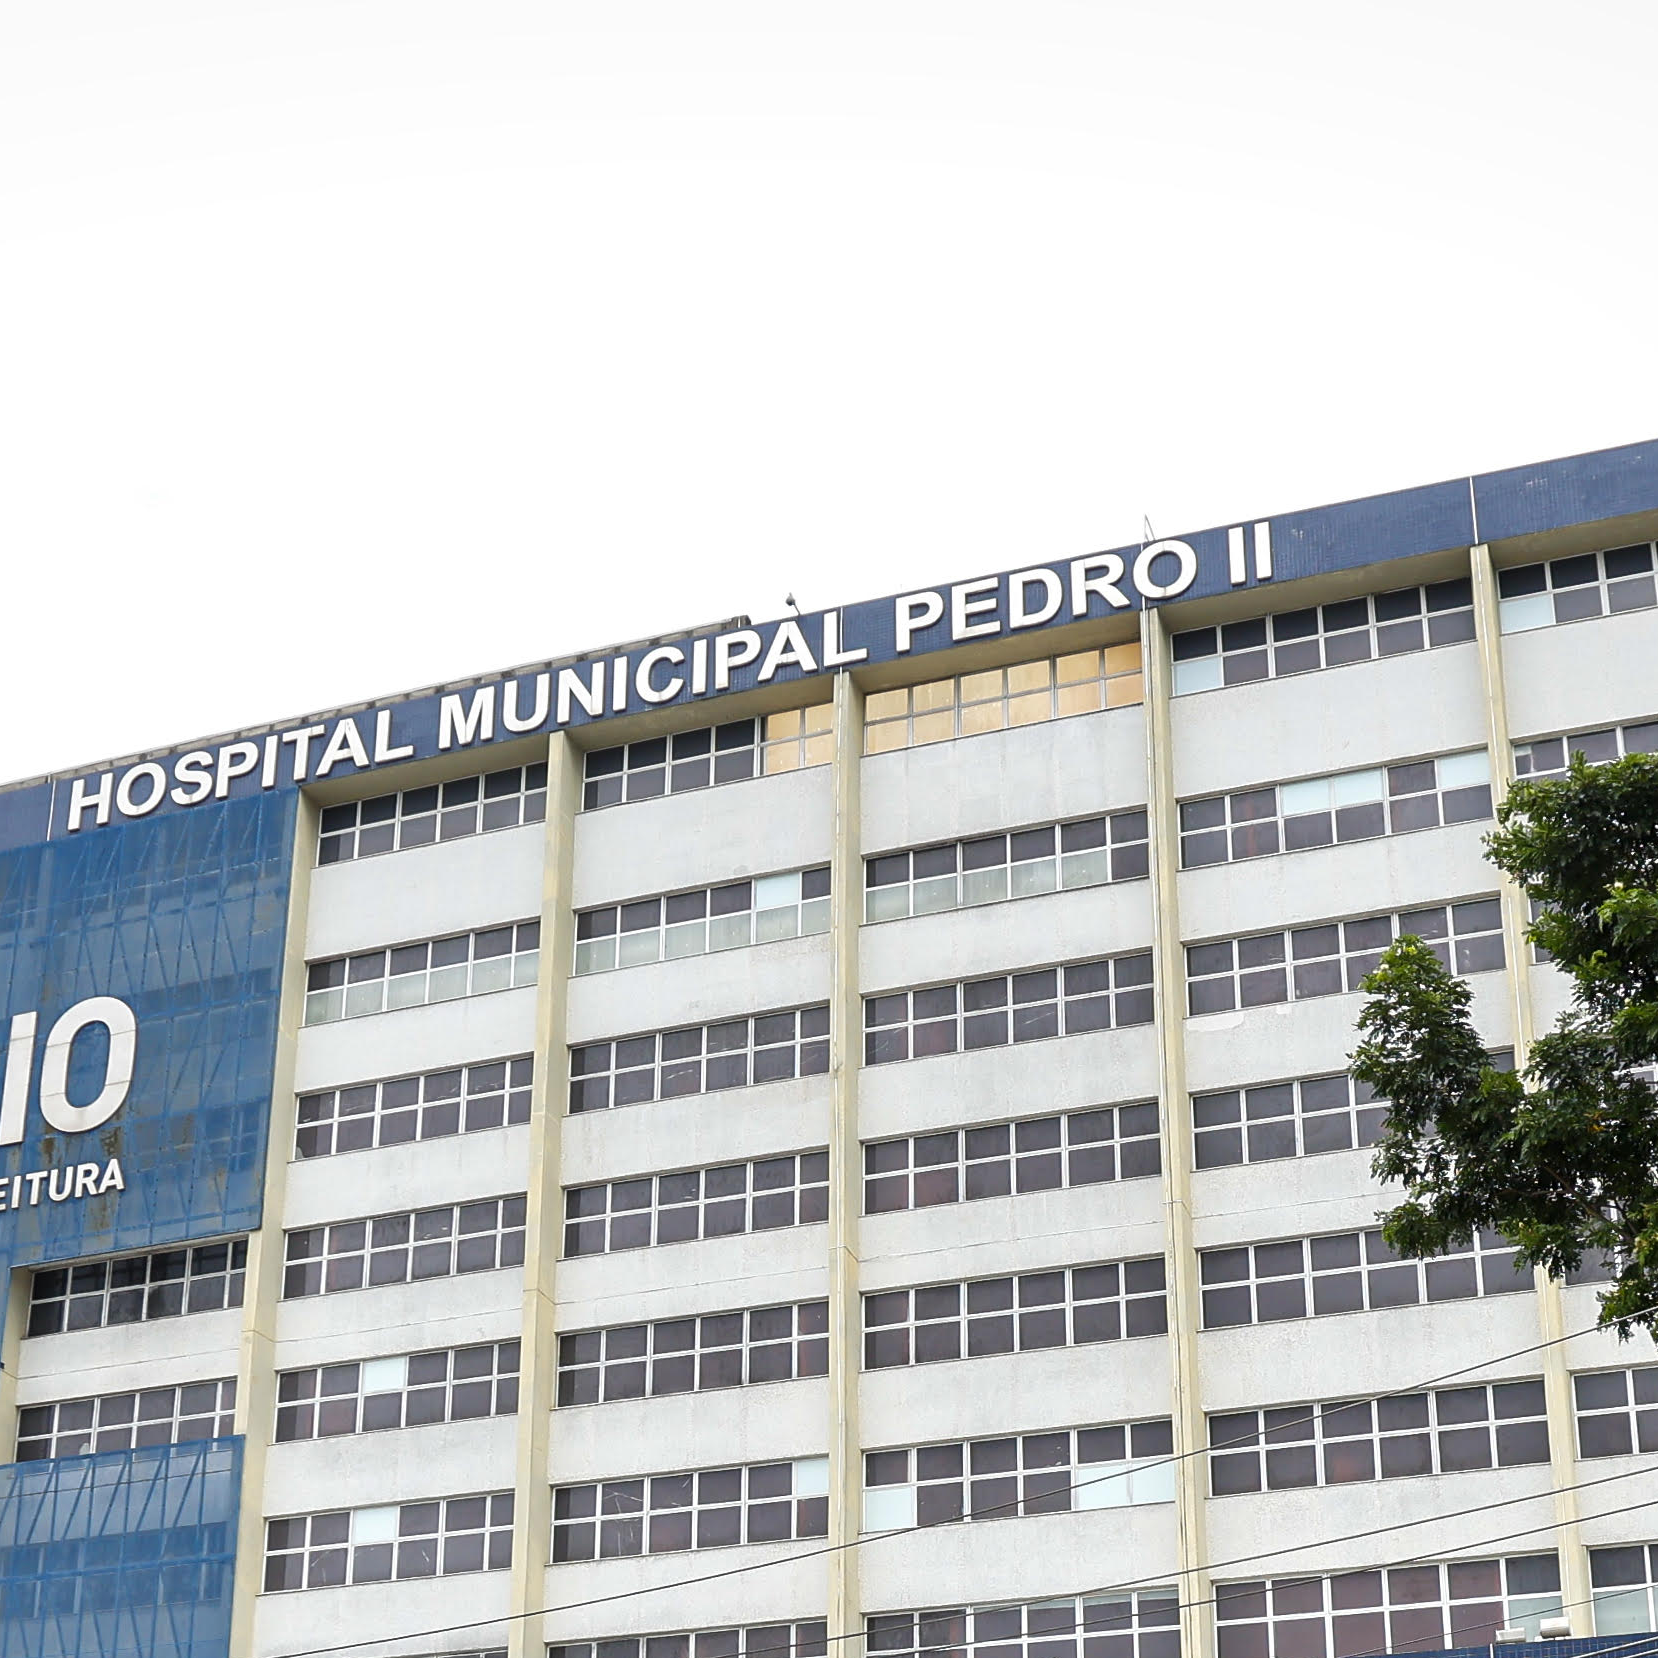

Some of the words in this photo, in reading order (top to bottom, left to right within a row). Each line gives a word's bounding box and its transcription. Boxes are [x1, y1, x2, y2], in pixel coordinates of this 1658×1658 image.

[67, 710, 414, 832] HOSPITAL
[439, 609, 868, 750] MUNICIPAL
[894, 538, 1199, 653] PEDRO
[1227, 521, 1273, 586] II
